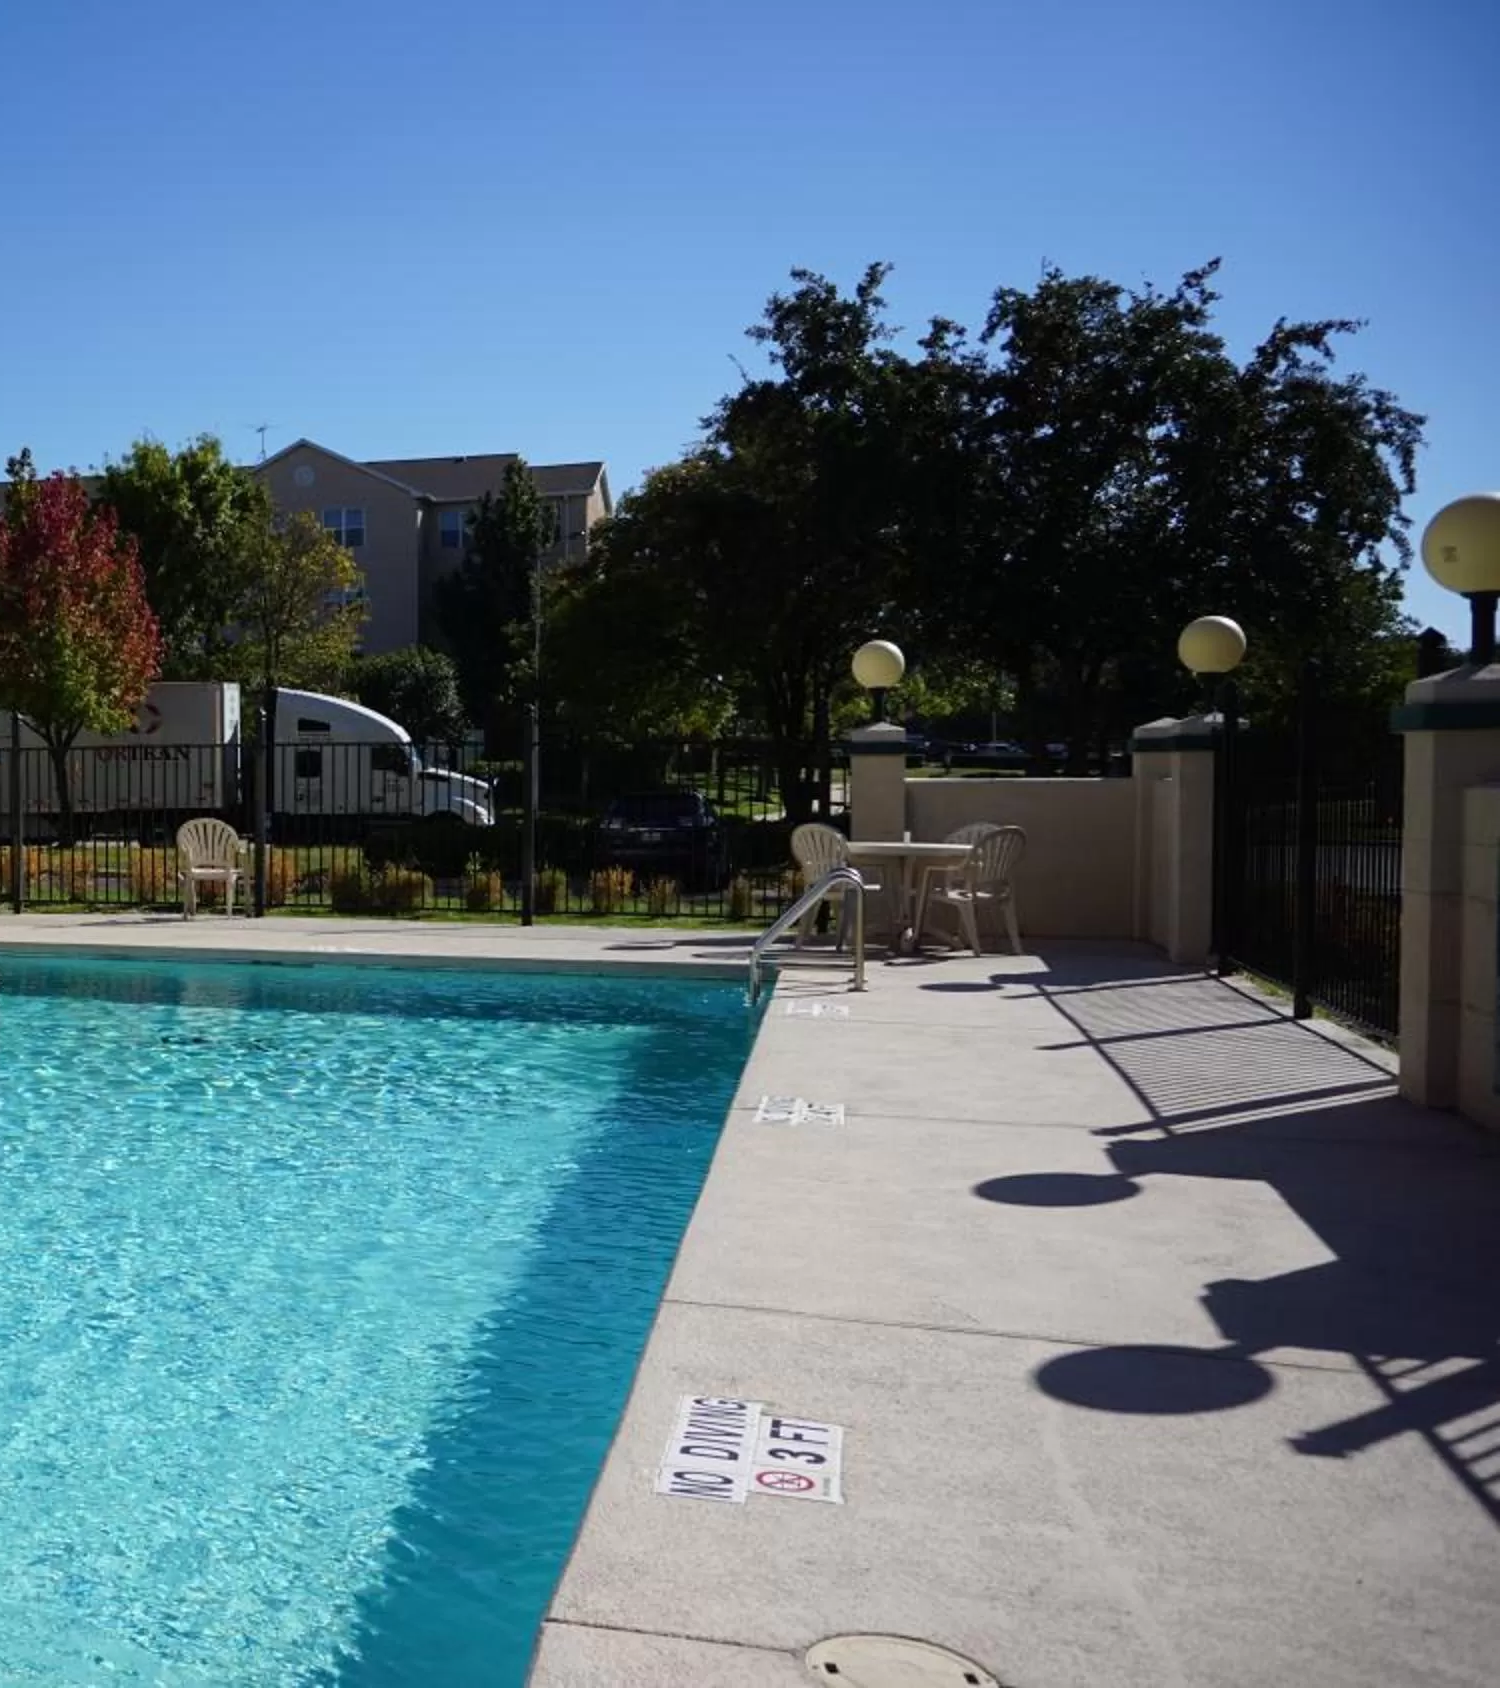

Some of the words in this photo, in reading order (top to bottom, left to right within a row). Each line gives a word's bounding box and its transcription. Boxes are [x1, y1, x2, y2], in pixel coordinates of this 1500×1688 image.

[679, 1398, 748, 1463] DIVING
[769, 1418, 829, 1446] FT
[767, 1447, 827, 1465] 3
[668, 1470, 734, 1500] NO
